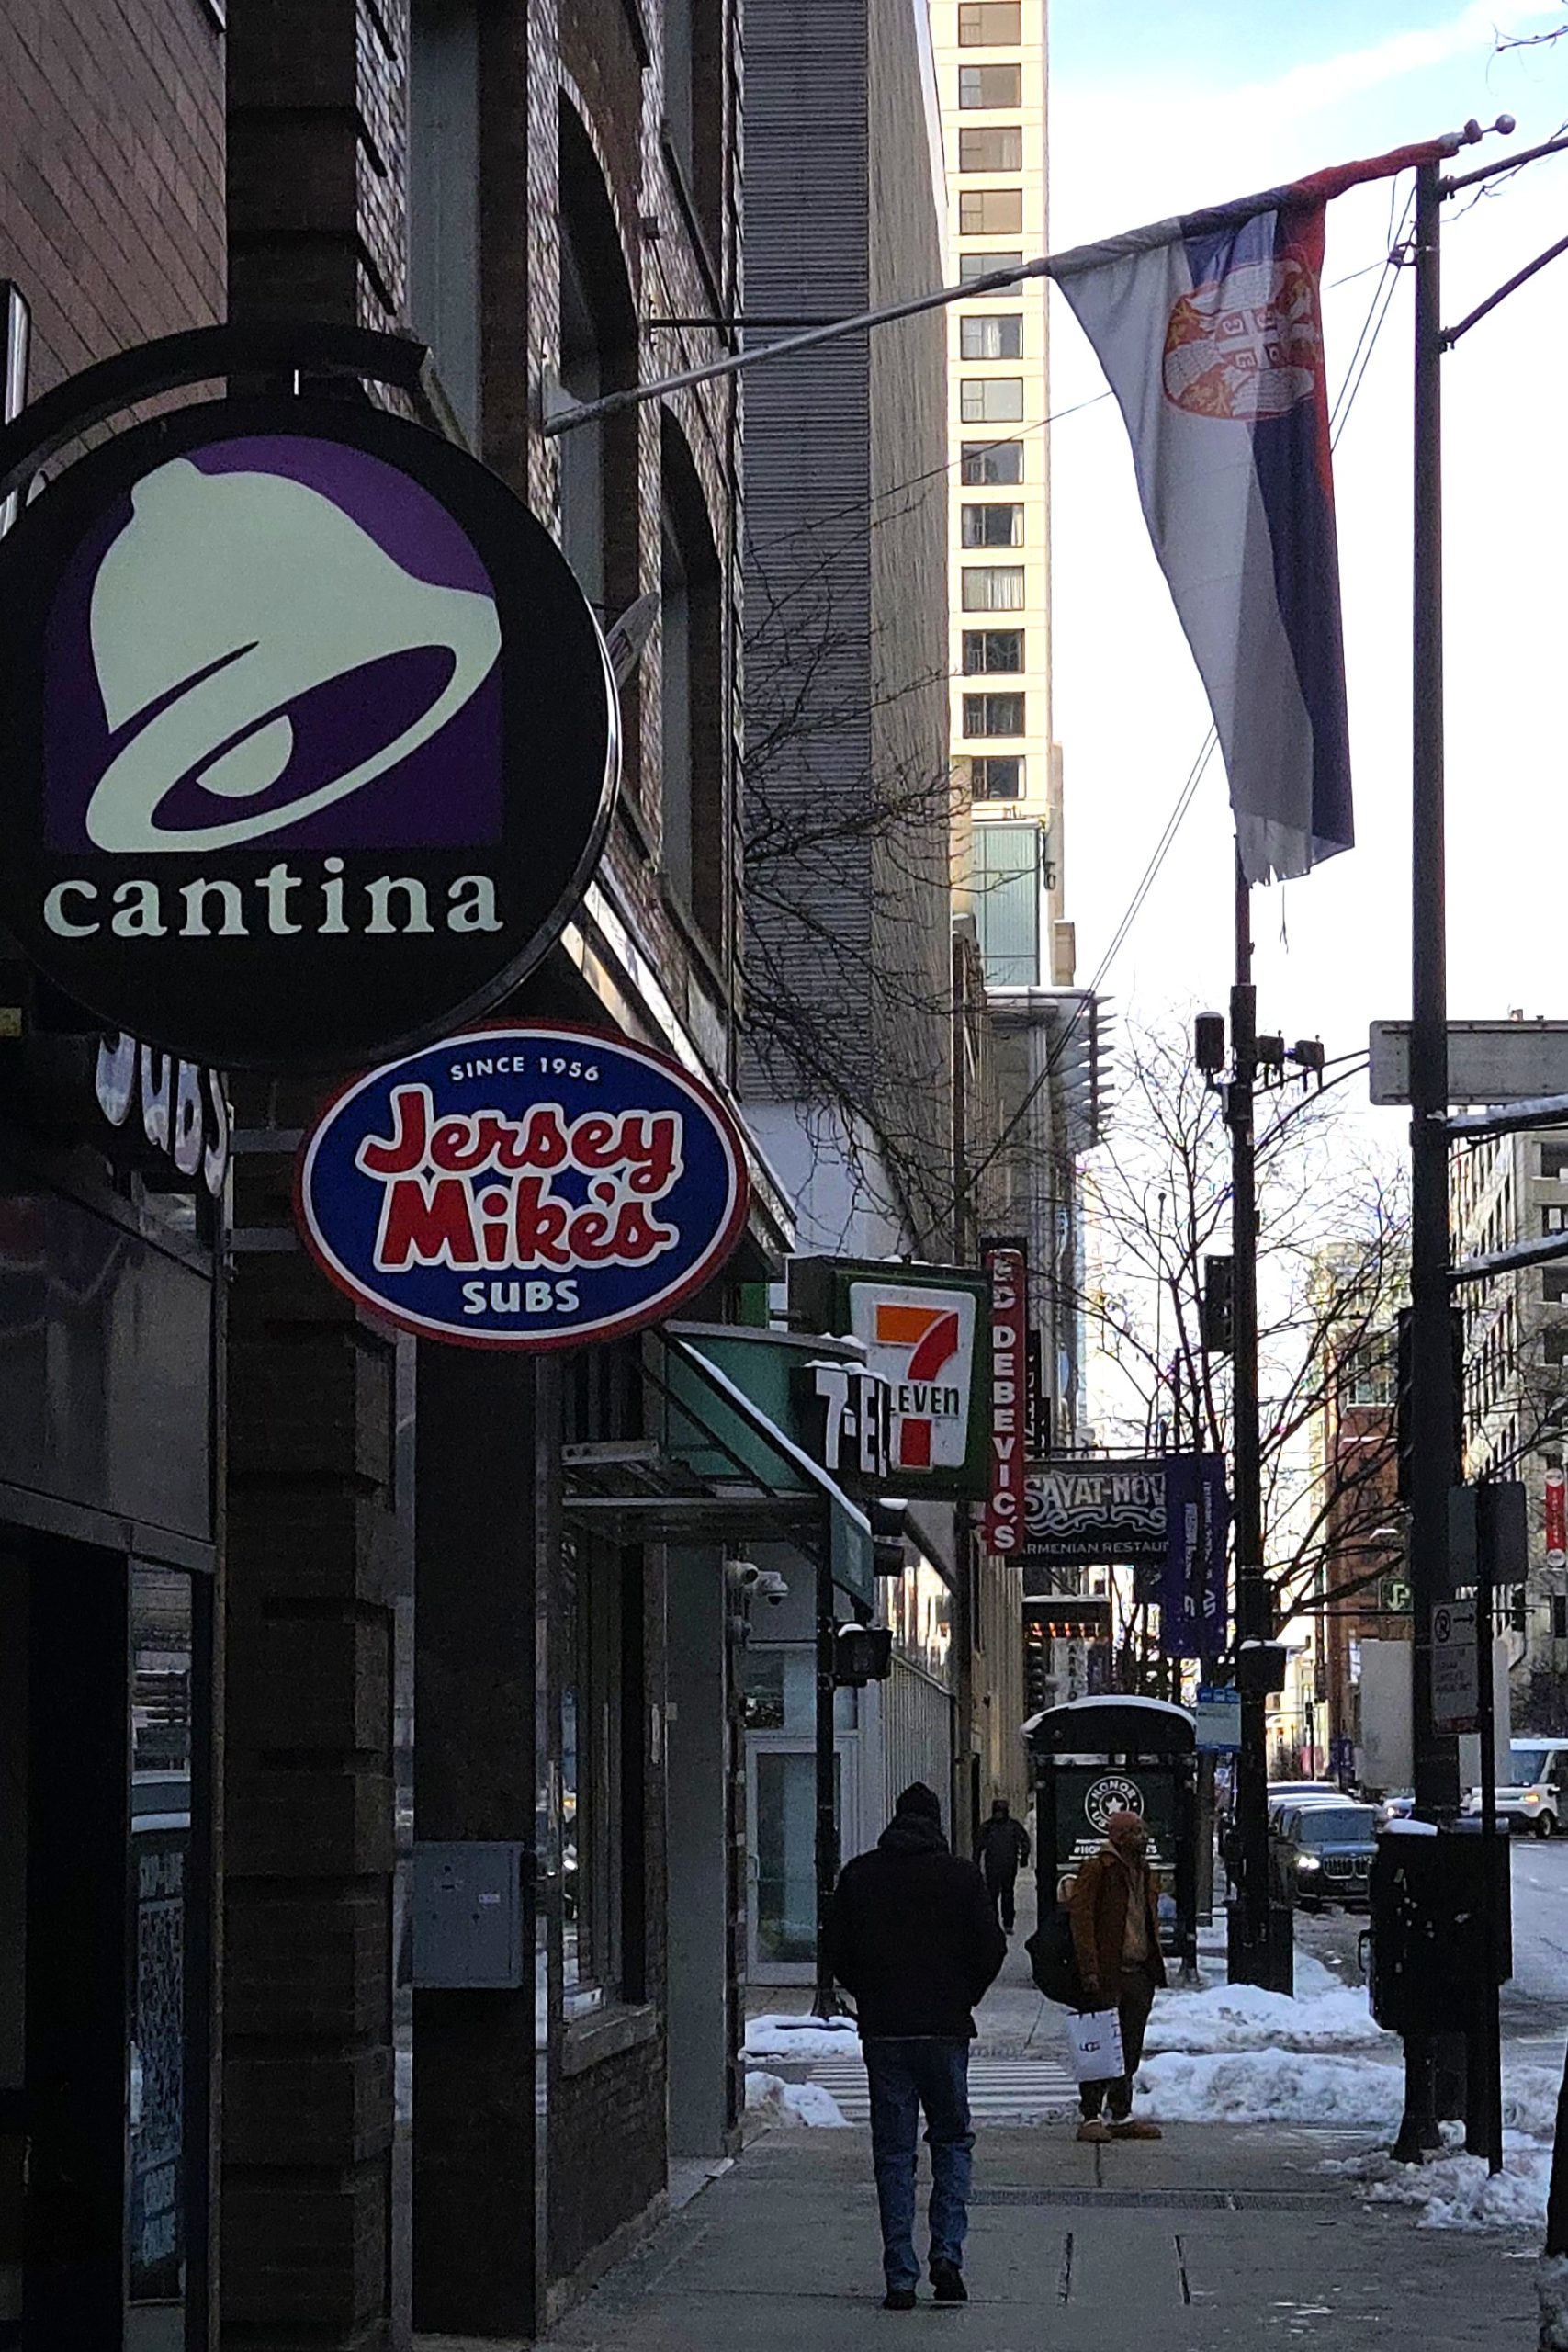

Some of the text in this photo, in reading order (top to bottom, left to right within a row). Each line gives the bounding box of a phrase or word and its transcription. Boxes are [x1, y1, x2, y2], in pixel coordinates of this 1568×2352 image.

[44, 856, 503, 937] cantina
[450, 1057, 599, 1081] SINCE 1956
[356, 1083, 682, 1200] Jersey
[376, 1170, 680, 1272] Mike's
[461, 1279, 580, 1314] SUBS
[991, 1325, 1018, 1549] DEBEVIC'S
[1023, 1471, 1167, 1521] SAYAT-NOV
[1023, 1541, 1170, 1555] RMENIAN RESTAU
[1091, 1780, 1136, 1800] HONOR
